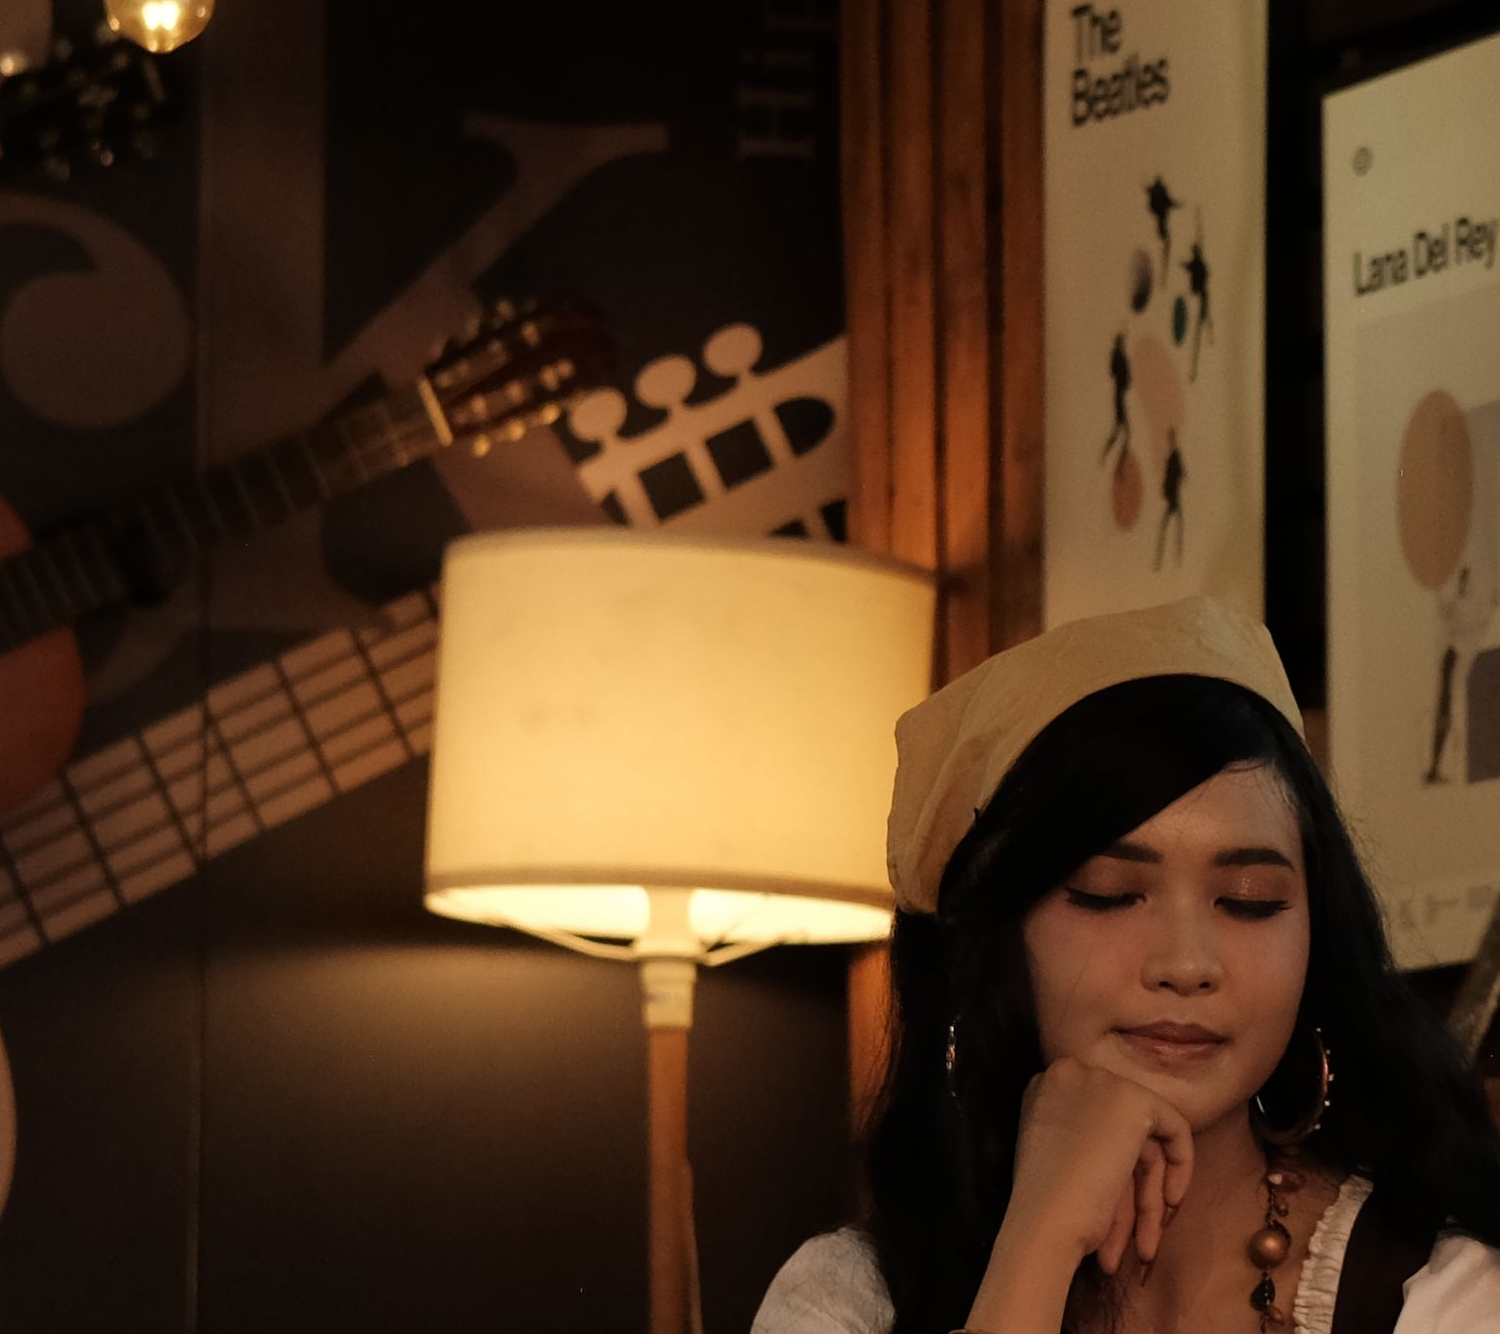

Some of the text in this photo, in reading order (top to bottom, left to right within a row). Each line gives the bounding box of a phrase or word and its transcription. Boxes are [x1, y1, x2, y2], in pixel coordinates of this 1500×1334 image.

[1071, 3, 1122, 63] The
[1071, 53, 1171, 128] Beatles
[1353, 248, 1408, 297] Lana
[1413, 223, 1449, 279] Del
[1455, 216, 1500, 270] Rey
